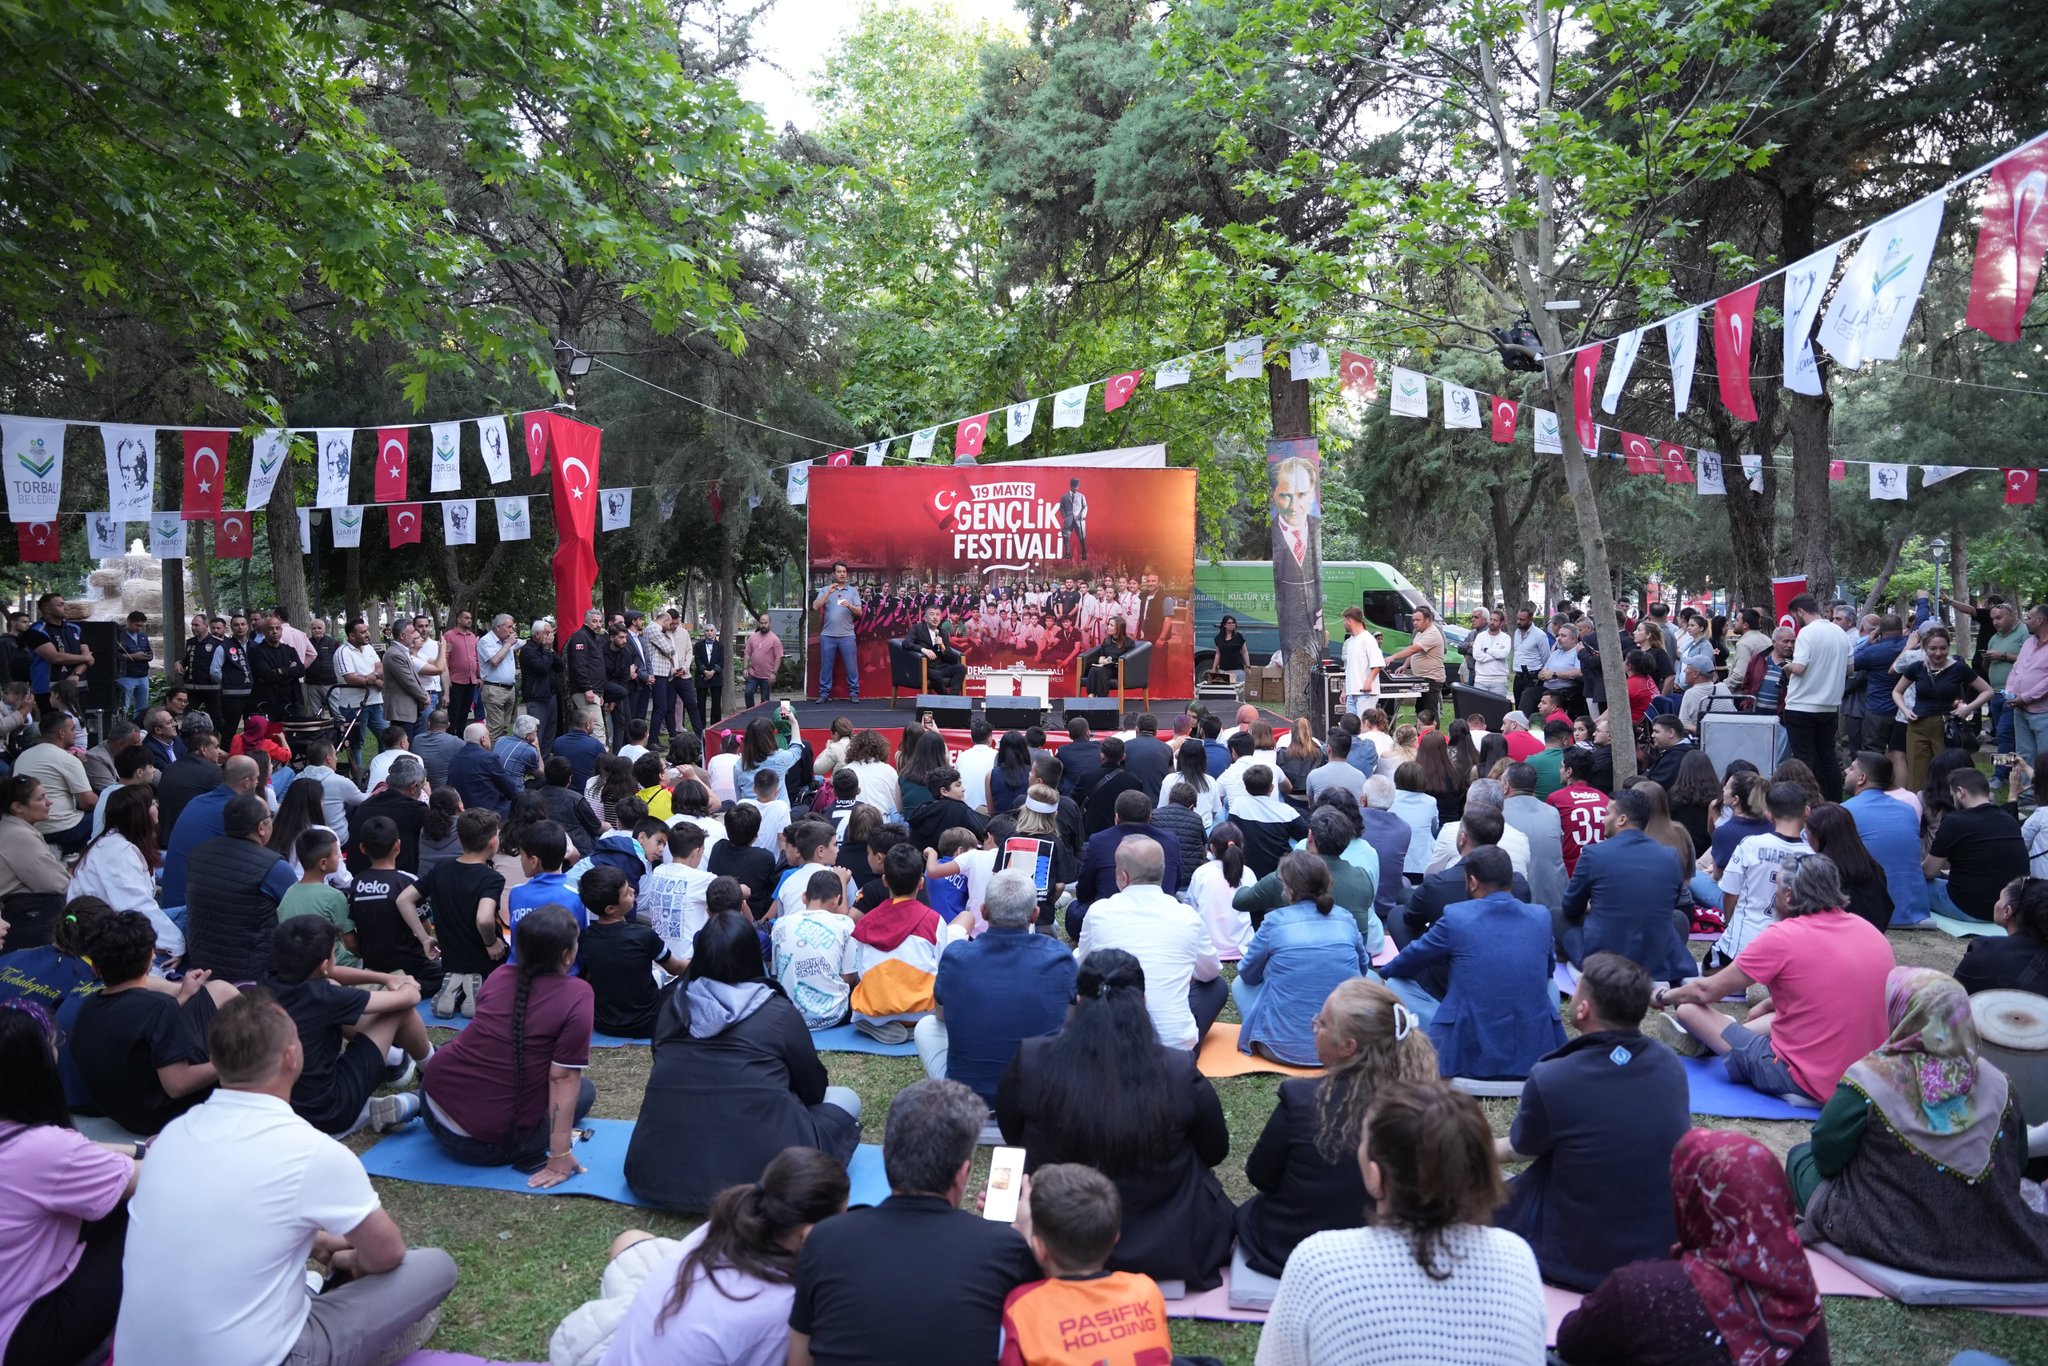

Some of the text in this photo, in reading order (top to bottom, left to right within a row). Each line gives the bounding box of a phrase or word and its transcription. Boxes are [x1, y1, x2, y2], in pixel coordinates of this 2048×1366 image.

[13, 480, 59, 494] TORBALI
[975, 484, 1033, 498] 19 MAYIS
[954, 498, 1062, 533] GENÇLİK
[954, 531, 1064, 560] FESTİVALİ
[1570, 791, 1600, 800] beko
[831, 810, 852, 842] 7
[1570, 806, 1607, 846] 35
[356, 880, 390, 894] beko
